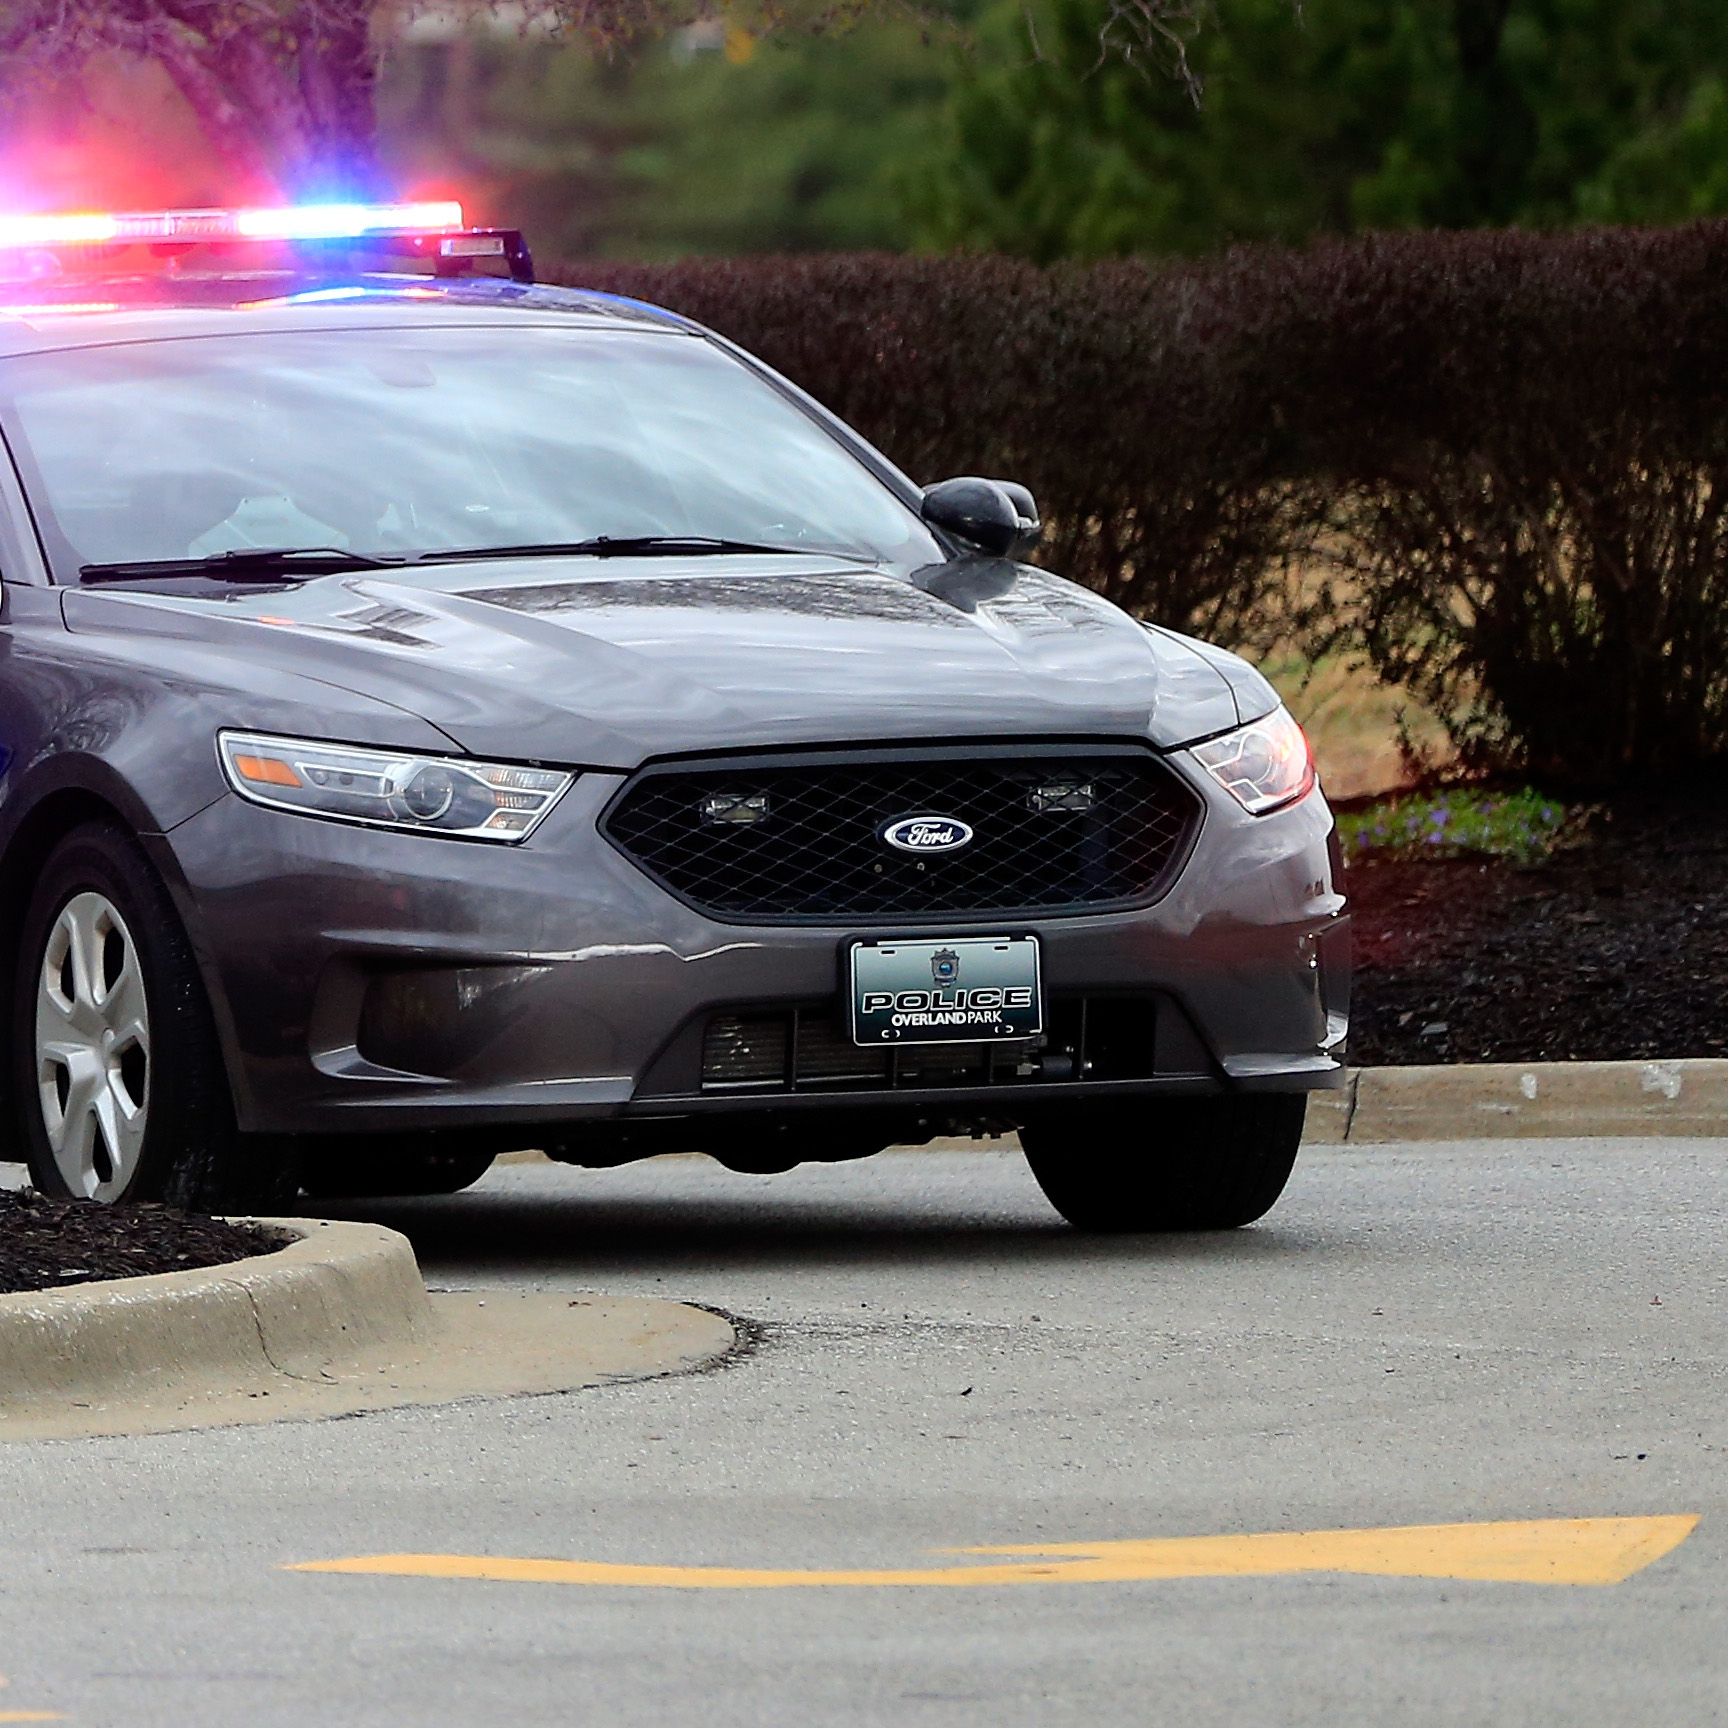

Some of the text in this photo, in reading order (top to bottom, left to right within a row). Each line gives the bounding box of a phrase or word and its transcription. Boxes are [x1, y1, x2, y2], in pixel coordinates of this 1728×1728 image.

[907, 823, 954, 845] Ford
[862, 987, 1033, 1014] POLICE
[891, 1010, 1003, 1027] OVERLAND PARK
